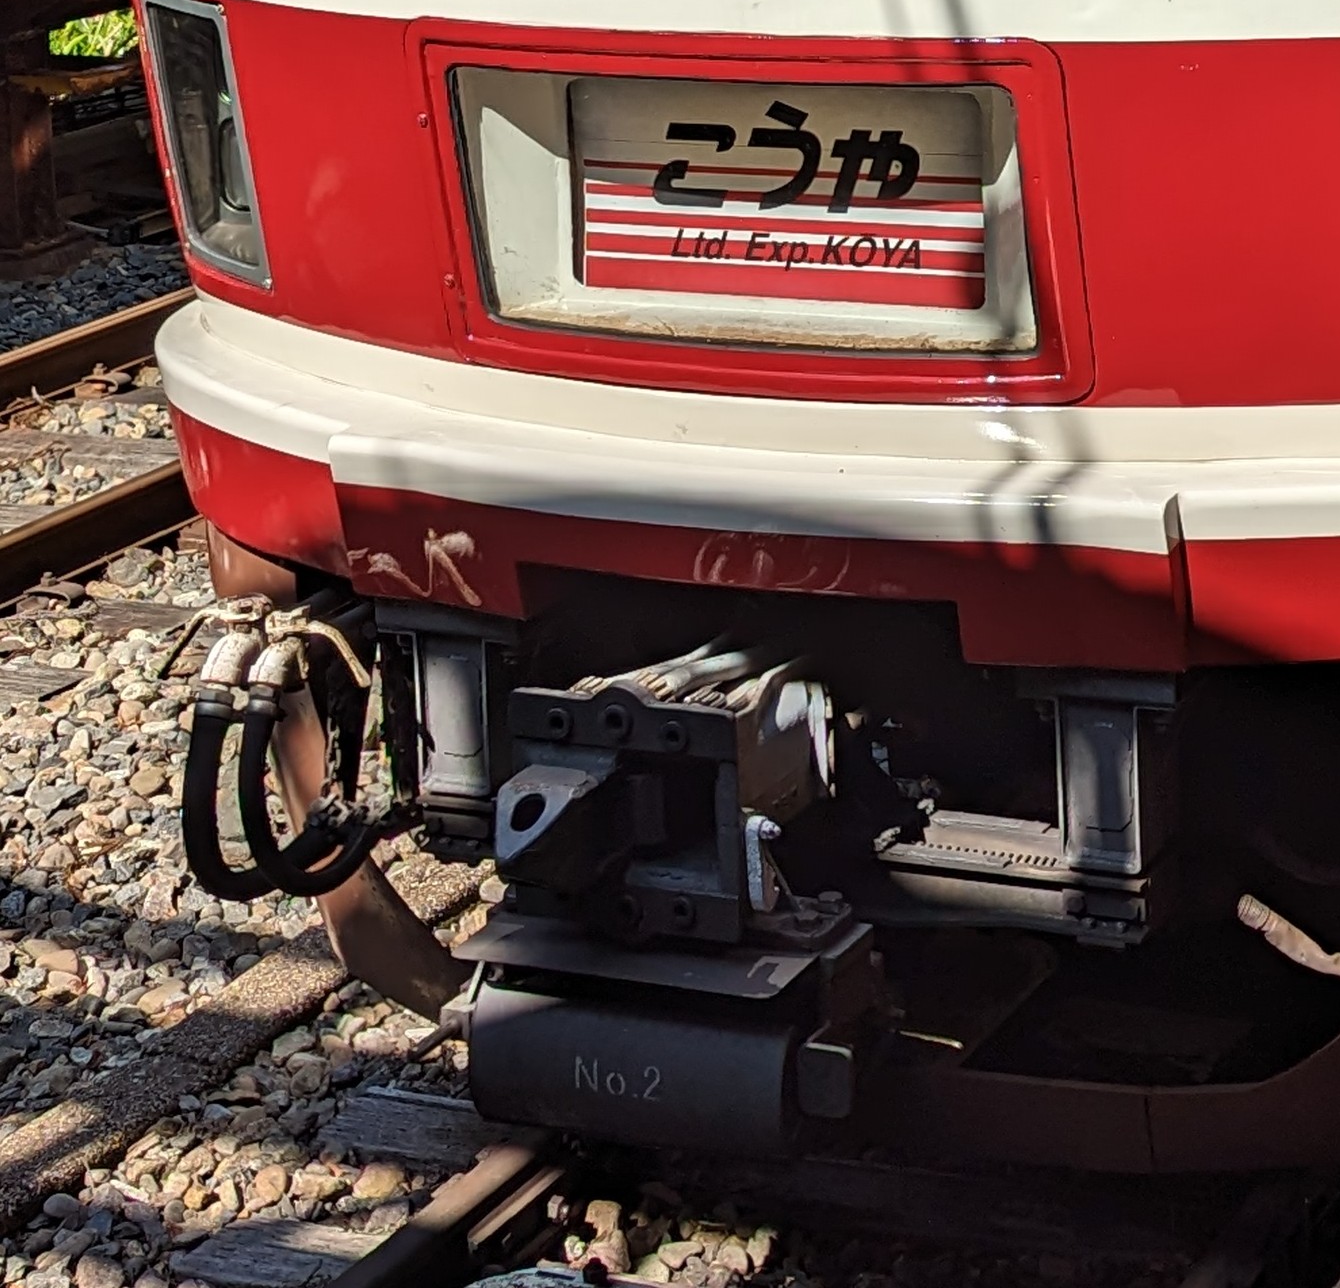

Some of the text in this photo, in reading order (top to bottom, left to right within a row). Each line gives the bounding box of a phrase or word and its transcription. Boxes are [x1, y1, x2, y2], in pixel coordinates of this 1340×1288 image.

[652, 100, 921, 214] こうや
[671, 228, 731, 260] Ltd.
[744, 231, 815, 272] Exp.
[574, 1056, 661, 1101] No.2
